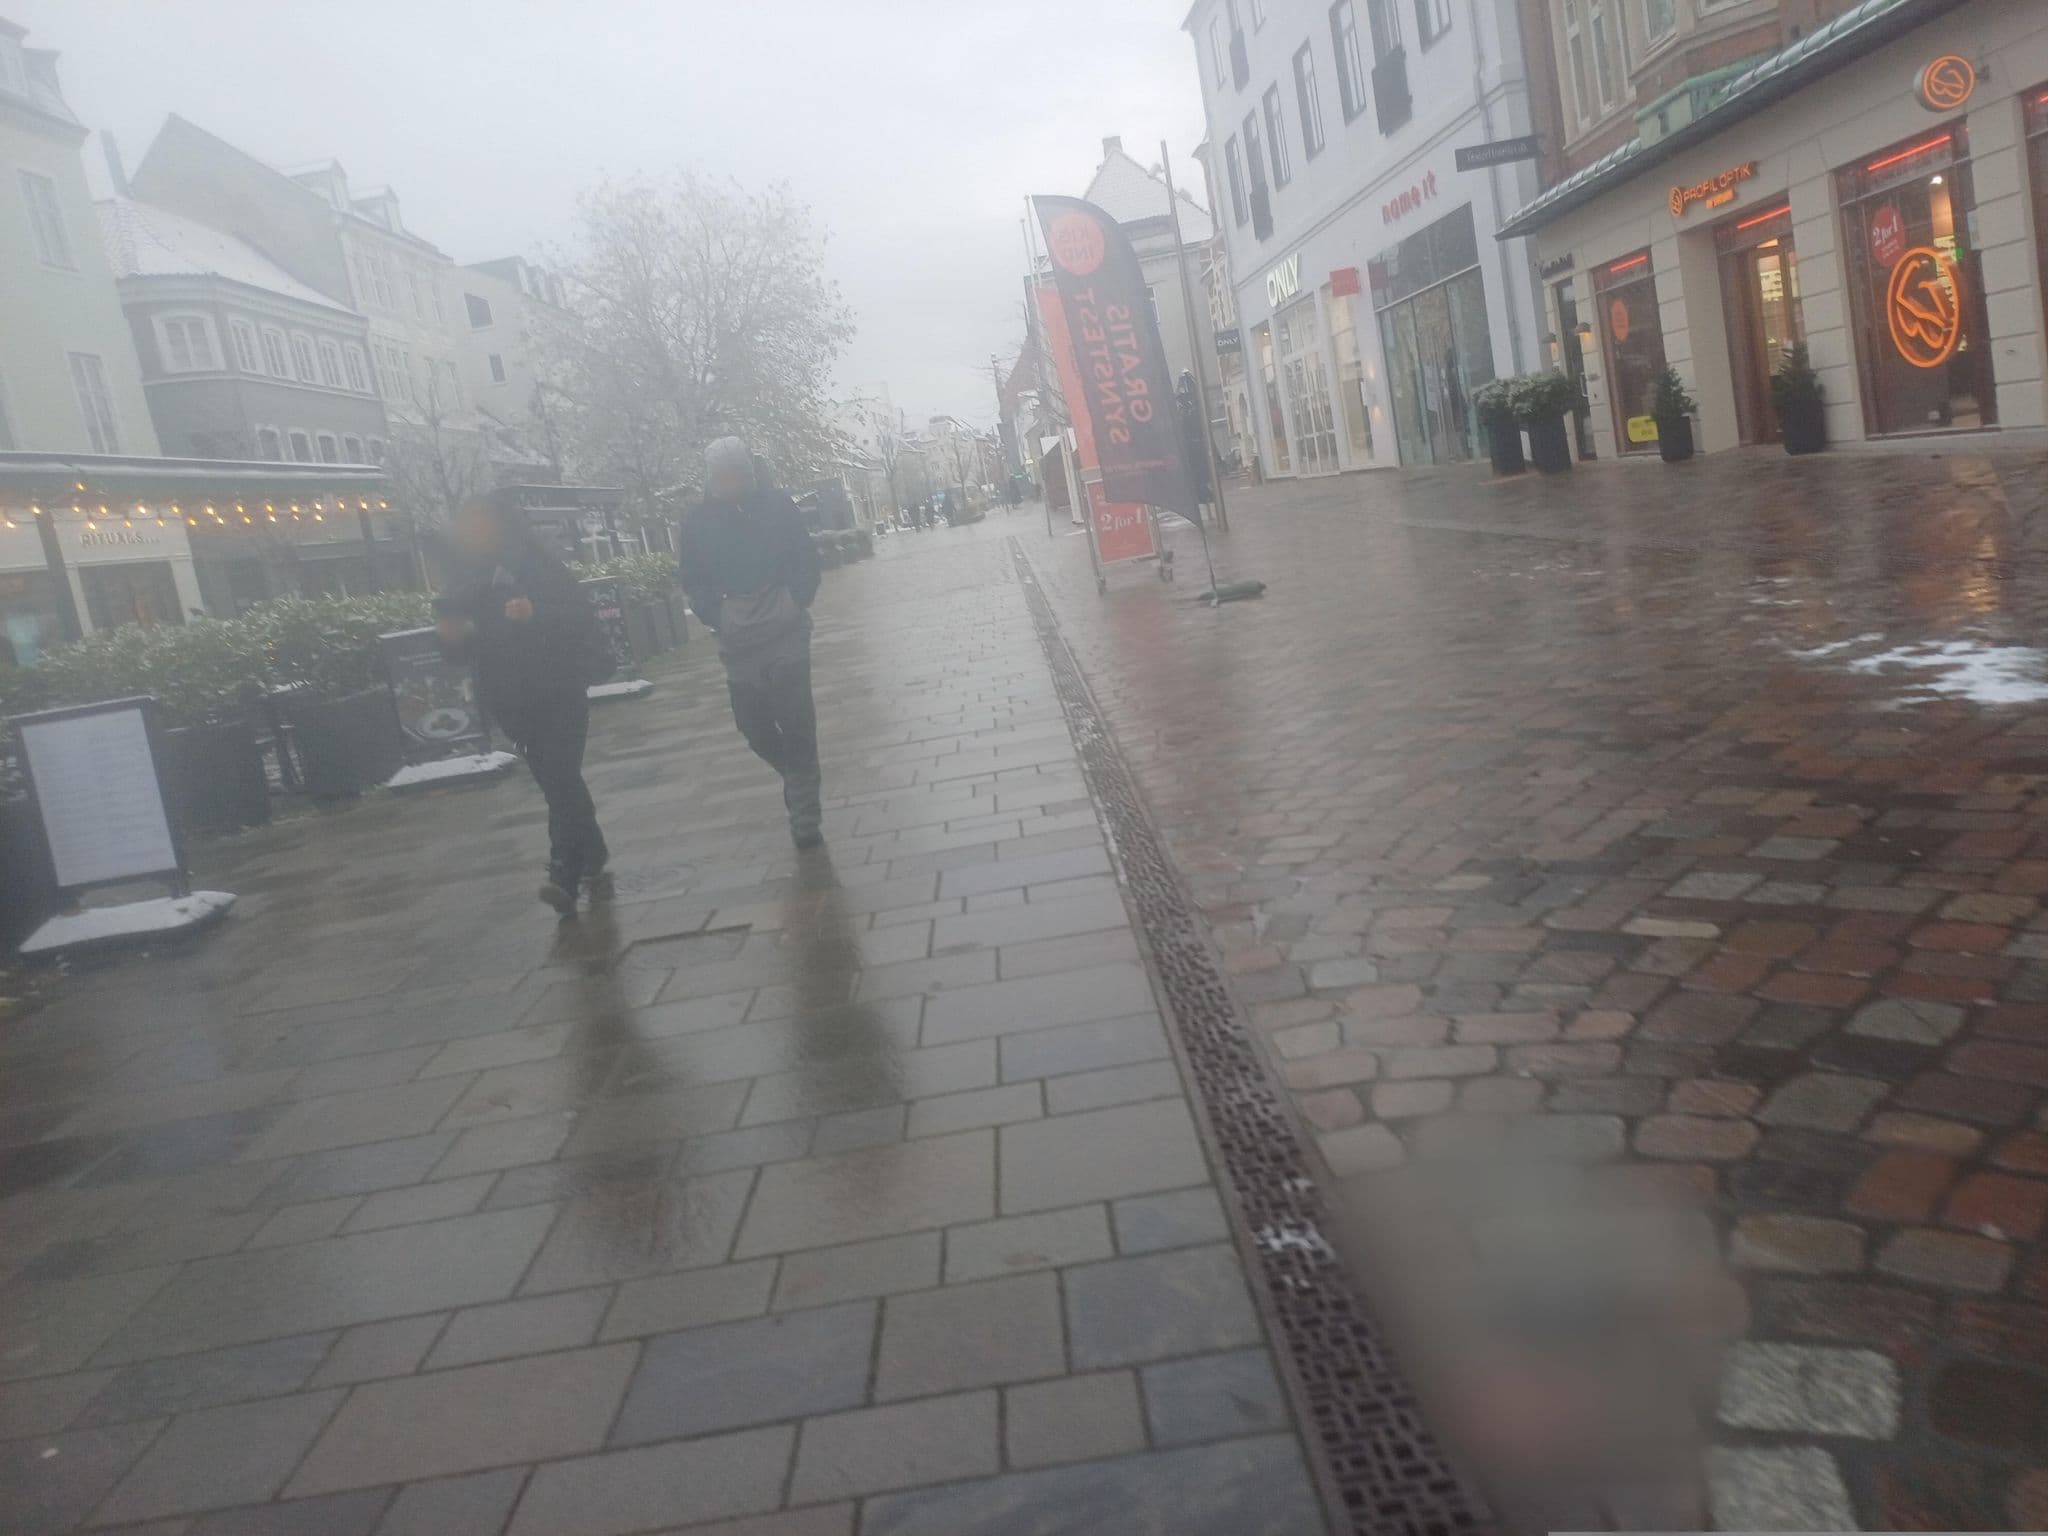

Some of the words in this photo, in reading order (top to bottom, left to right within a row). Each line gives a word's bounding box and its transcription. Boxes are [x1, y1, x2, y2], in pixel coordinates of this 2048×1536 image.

[1382, 185, 1422, 225] name
[1422, 169, 1438, 201] it
[1682, 180, 1719, 203] PROFIL
[1719, 161, 1752, 188] OPTIK
[1872, 227, 1882, 247] 2
[1266, 252, 1301, 308] ONLY
[1217, 337, 1238, 346] ONLY
[1100, 513, 1113, 532] 2
[1114, 515, 1135, 531] for
[1136, 506, 1143, 525] 1
